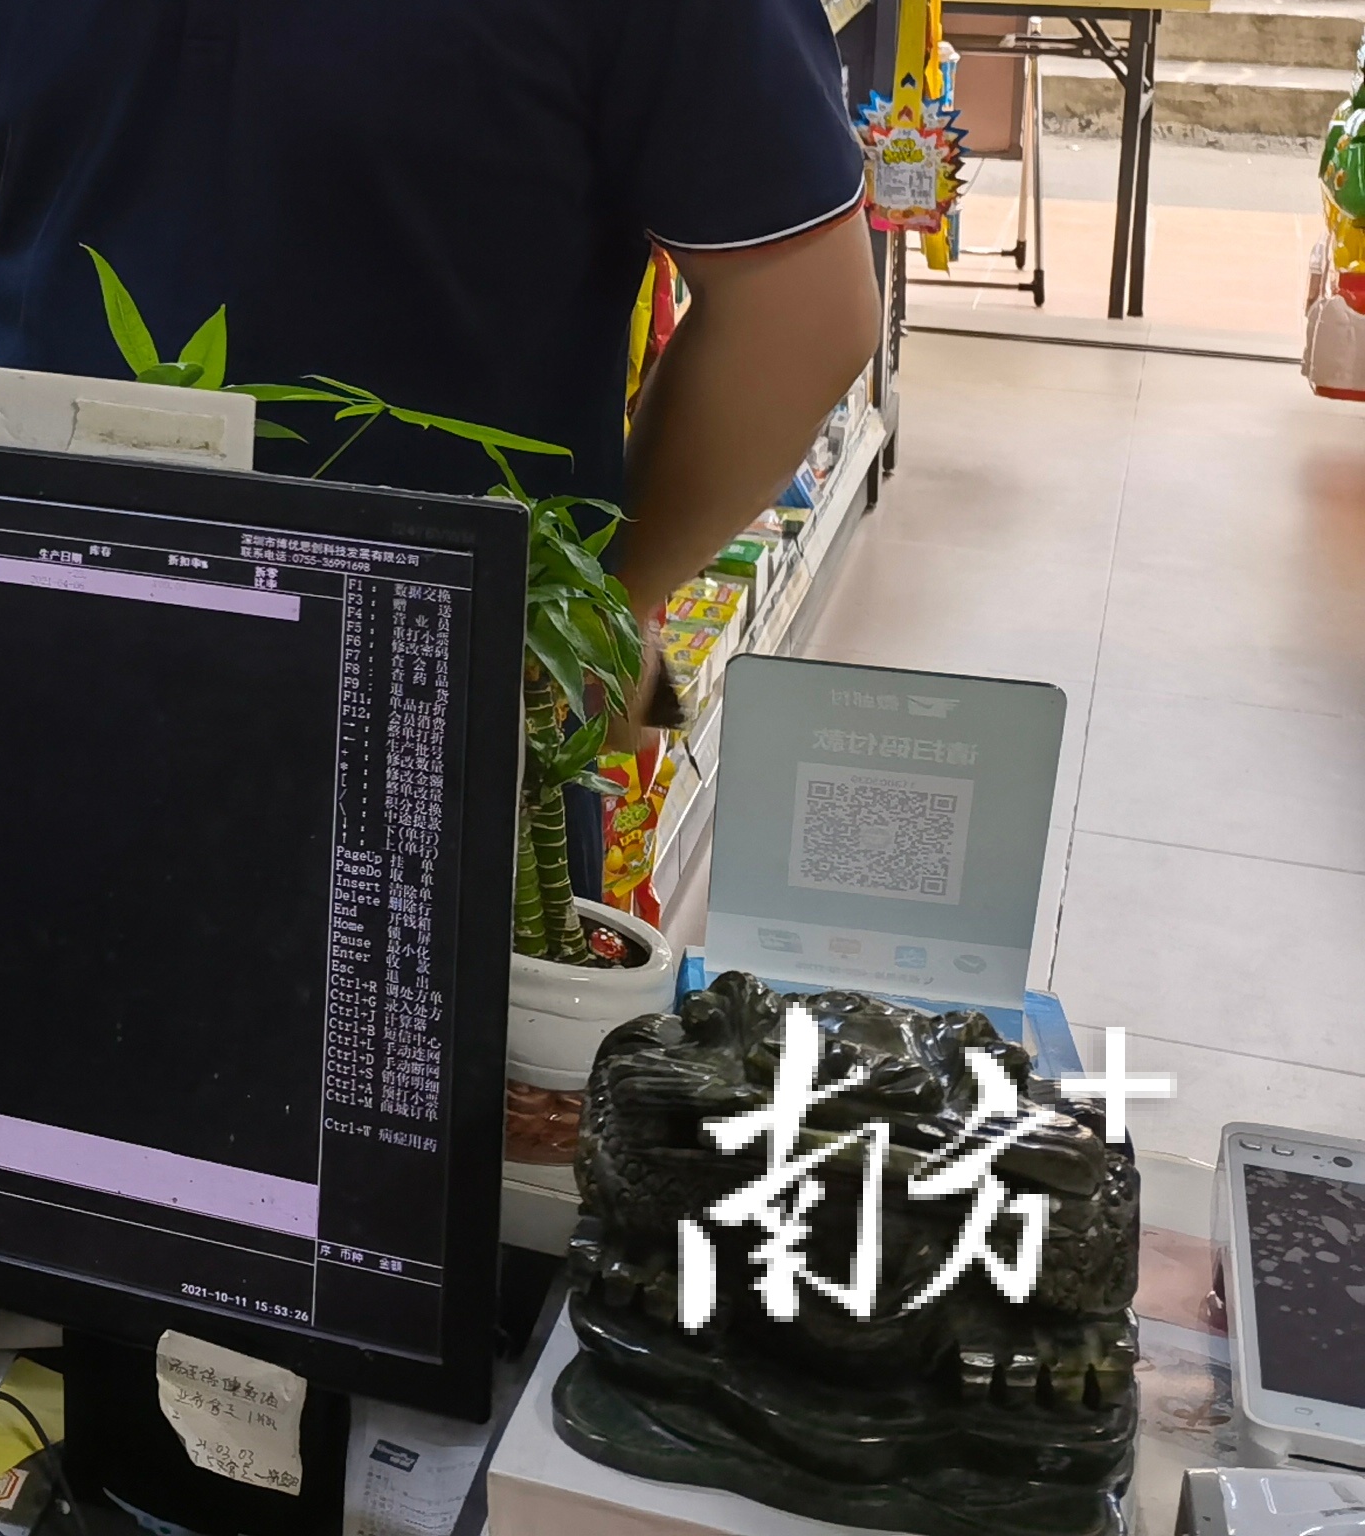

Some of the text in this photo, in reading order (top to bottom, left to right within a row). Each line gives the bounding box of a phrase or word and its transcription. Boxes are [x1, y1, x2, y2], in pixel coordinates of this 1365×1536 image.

[347, 592, 363, 606] F3
[348, 578, 452, 604] F1 数据交换
[347, 606, 362, 619] F4
[346, 620, 450, 646] F5 重打小票
[345, 634, 449, 660] F6 修改密码
[345, 648, 361, 661] F7
[344, 662, 360, 675] F8
[343, 676, 359, 689] F9
[336, 845, 383, 865] PageUp
[335, 859, 382, 878] PageDo
[336, 874, 381, 893] Insert
[334, 887, 381, 906] Delete
[333, 902, 358, 917] End
[333, 916, 364, 932] Home
[332, 930, 372, 949] Pause
[332, 944, 372, 963] Enter
[331, 959, 355, 974] Esc
[331, 973, 378, 993] Ctrl+R
[330, 988, 377, 1008] Ctrl+G
[329, 1002, 376, 1023] Ctrl+J
[329, 1017, 376, 1036] Ctrl+B
[328, 1031, 375, 1051] Ctrl+L
[327, 1046, 374, 1065] Ctrl+D
[327, 1060, 374, 1079] Ctrl+S
[326, 1074, 373, 1095] Ctrl+A
[340, 1248, 364, 1263] 币种
[181, 1282, 309, 1322] 2021-10-11 15:53:26
